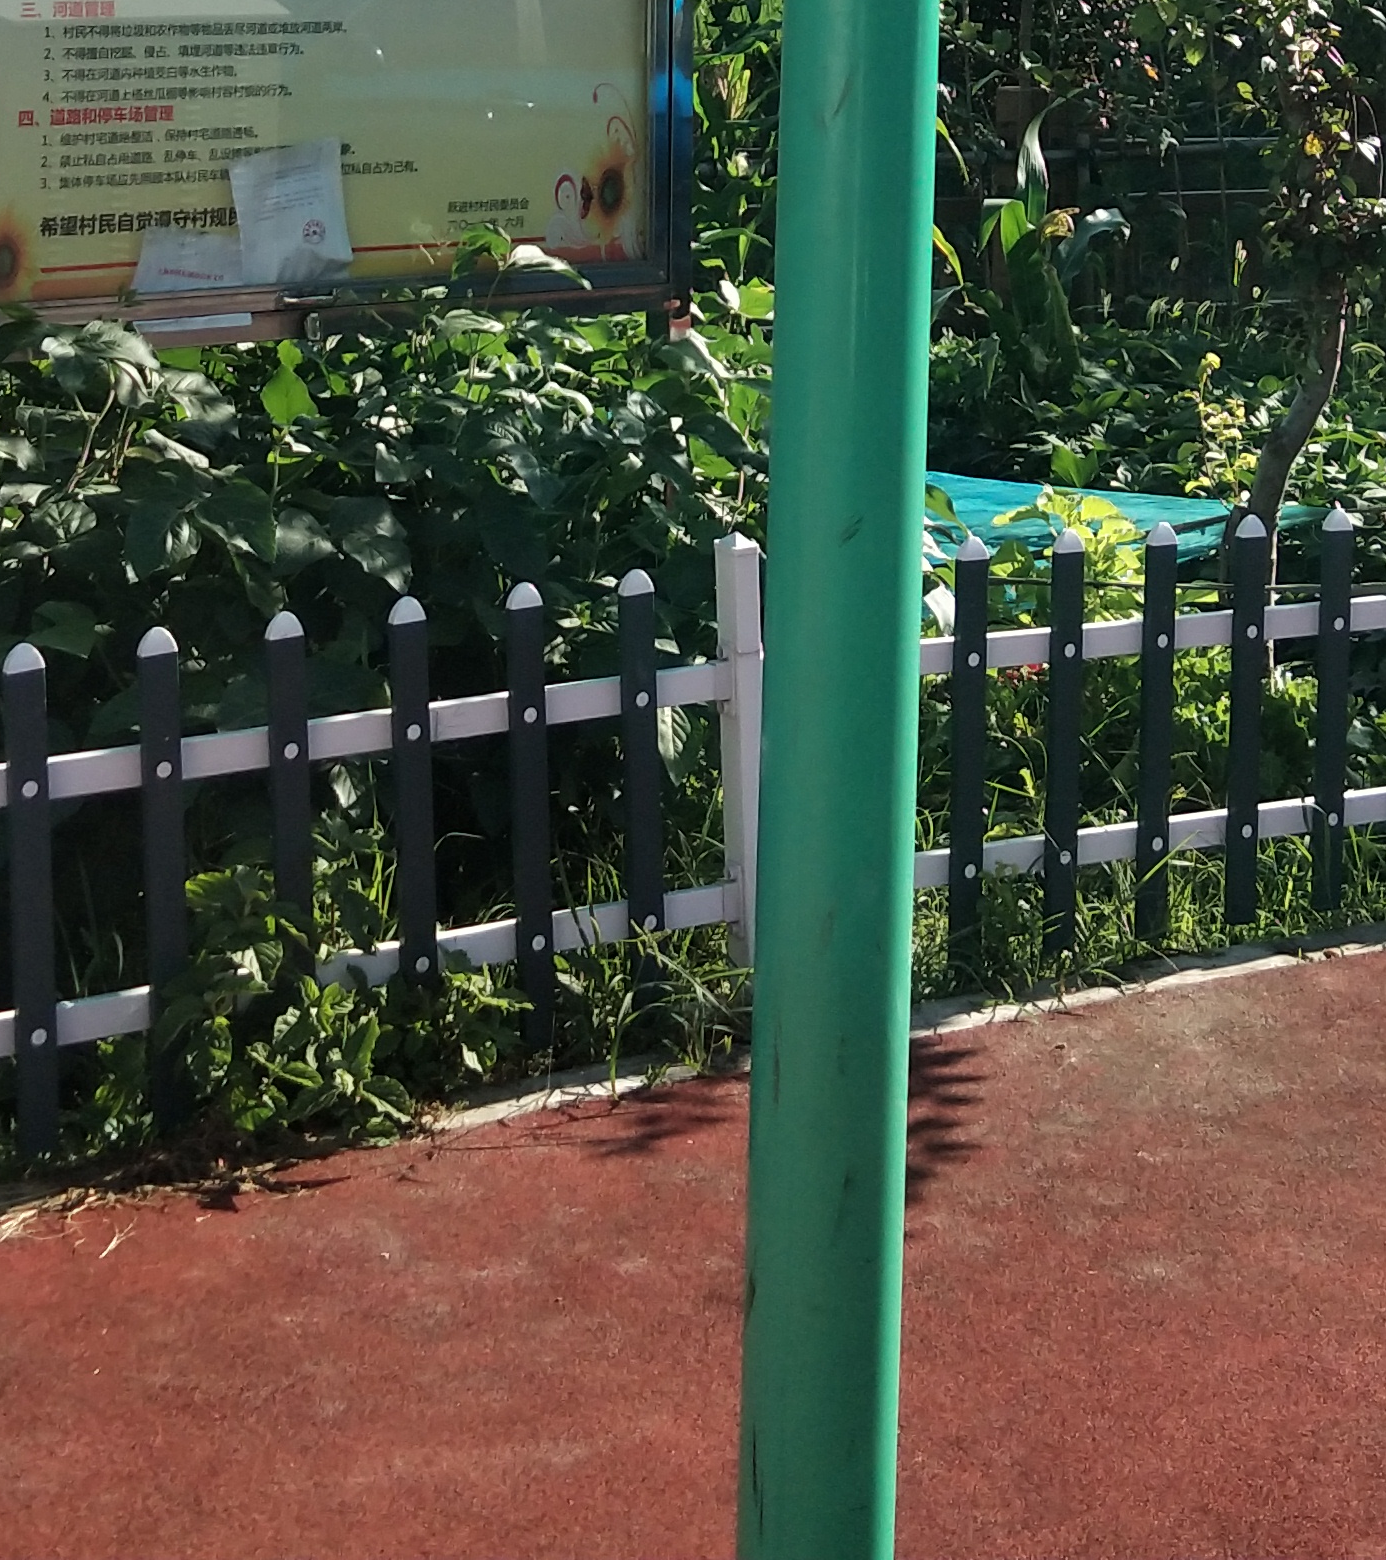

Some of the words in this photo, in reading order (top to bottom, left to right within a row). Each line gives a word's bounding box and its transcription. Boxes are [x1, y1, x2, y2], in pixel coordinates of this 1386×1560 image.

[20, 1, 116, 18] 三、河道管理
[18, 104, 174, 127] 四、道路和停车场管理
